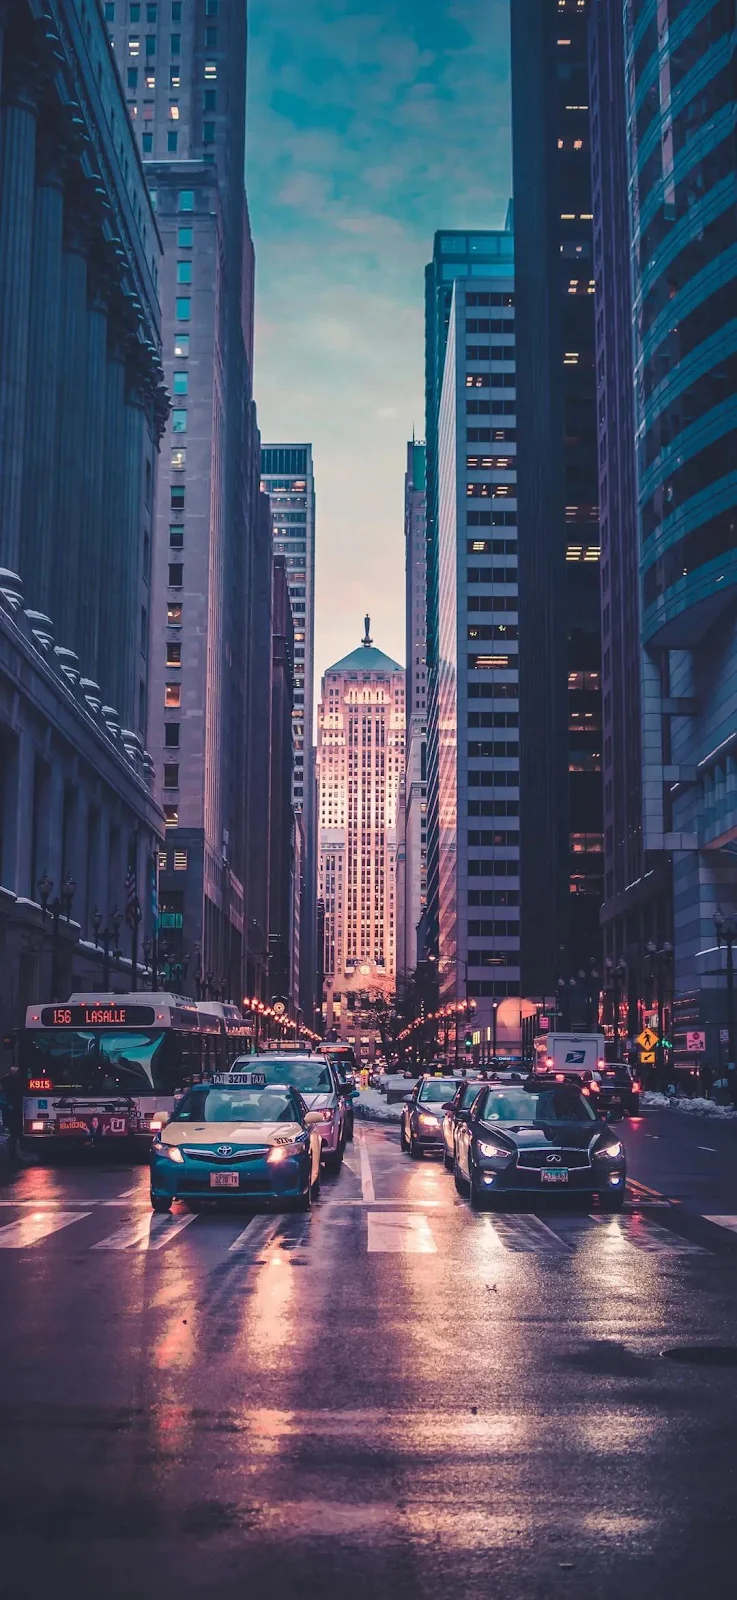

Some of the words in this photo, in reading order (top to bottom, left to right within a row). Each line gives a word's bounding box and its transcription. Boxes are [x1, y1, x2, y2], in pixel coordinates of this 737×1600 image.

[53, 1009, 72, 1024] 156
[85, 1010, 126, 1023] LASALLE
[29, 1079, 50, 1089] K915
[228, 1075, 248, 1084] 3270
[252, 1075, 265, 1084] TAXI
